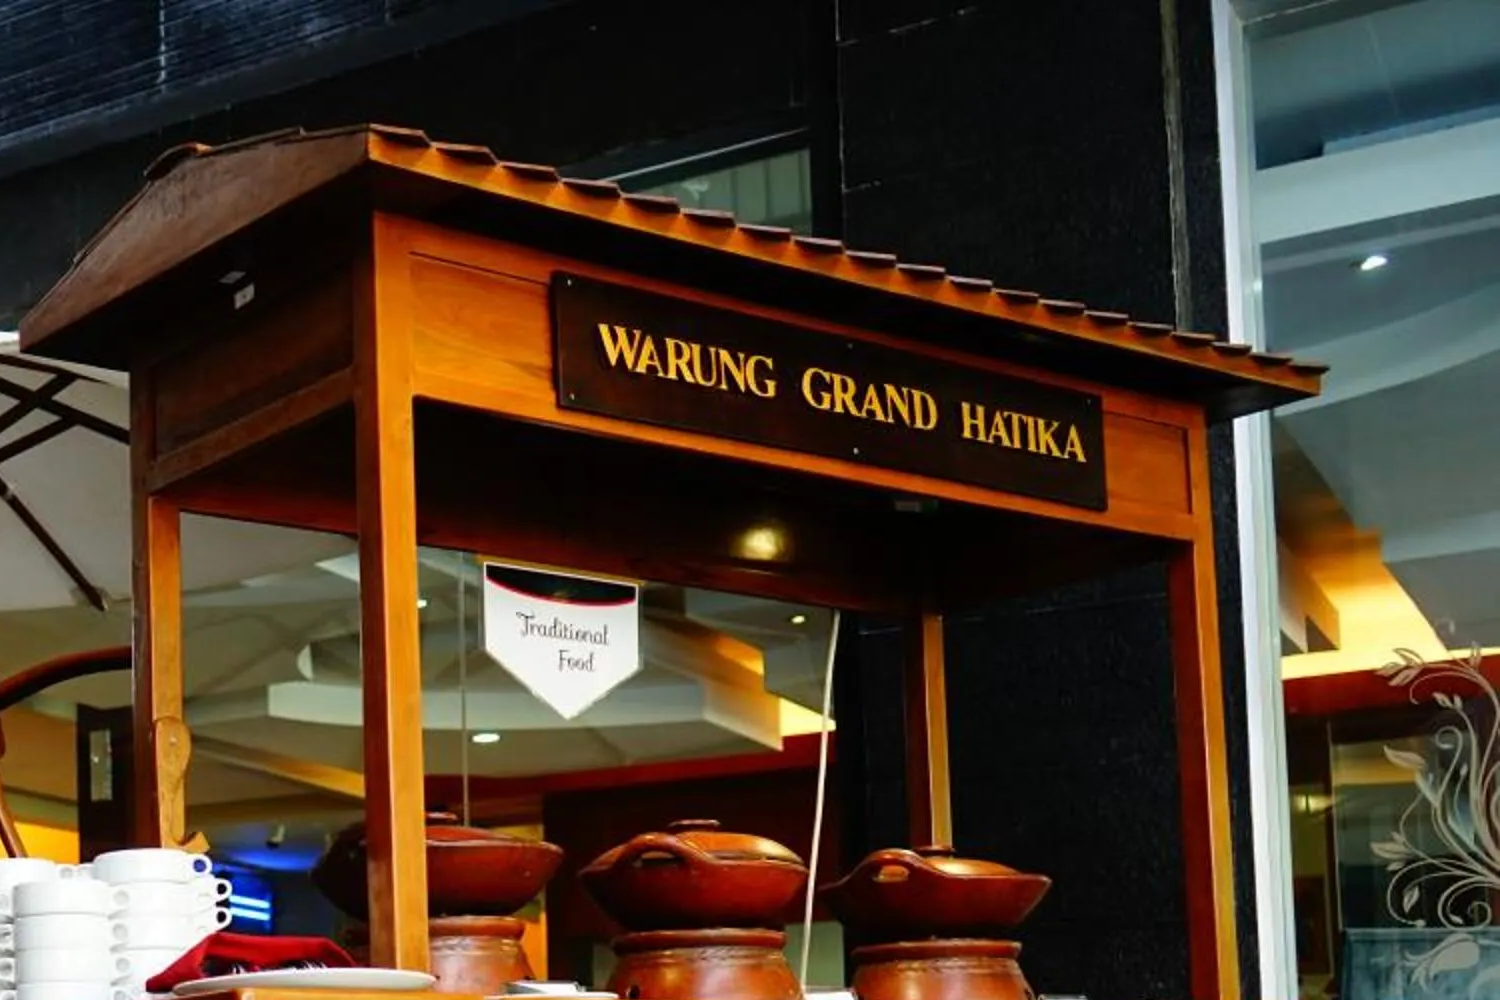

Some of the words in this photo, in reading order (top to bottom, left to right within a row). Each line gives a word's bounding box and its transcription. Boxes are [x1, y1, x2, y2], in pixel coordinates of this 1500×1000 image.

[598, 323, 777, 398] WARUNG
[802, 367, 938, 431] GRAND
[961, 401, 1087, 463] HATIKA
[515, 611, 609, 646] Traditional
[558, 649, 595, 672] Food
